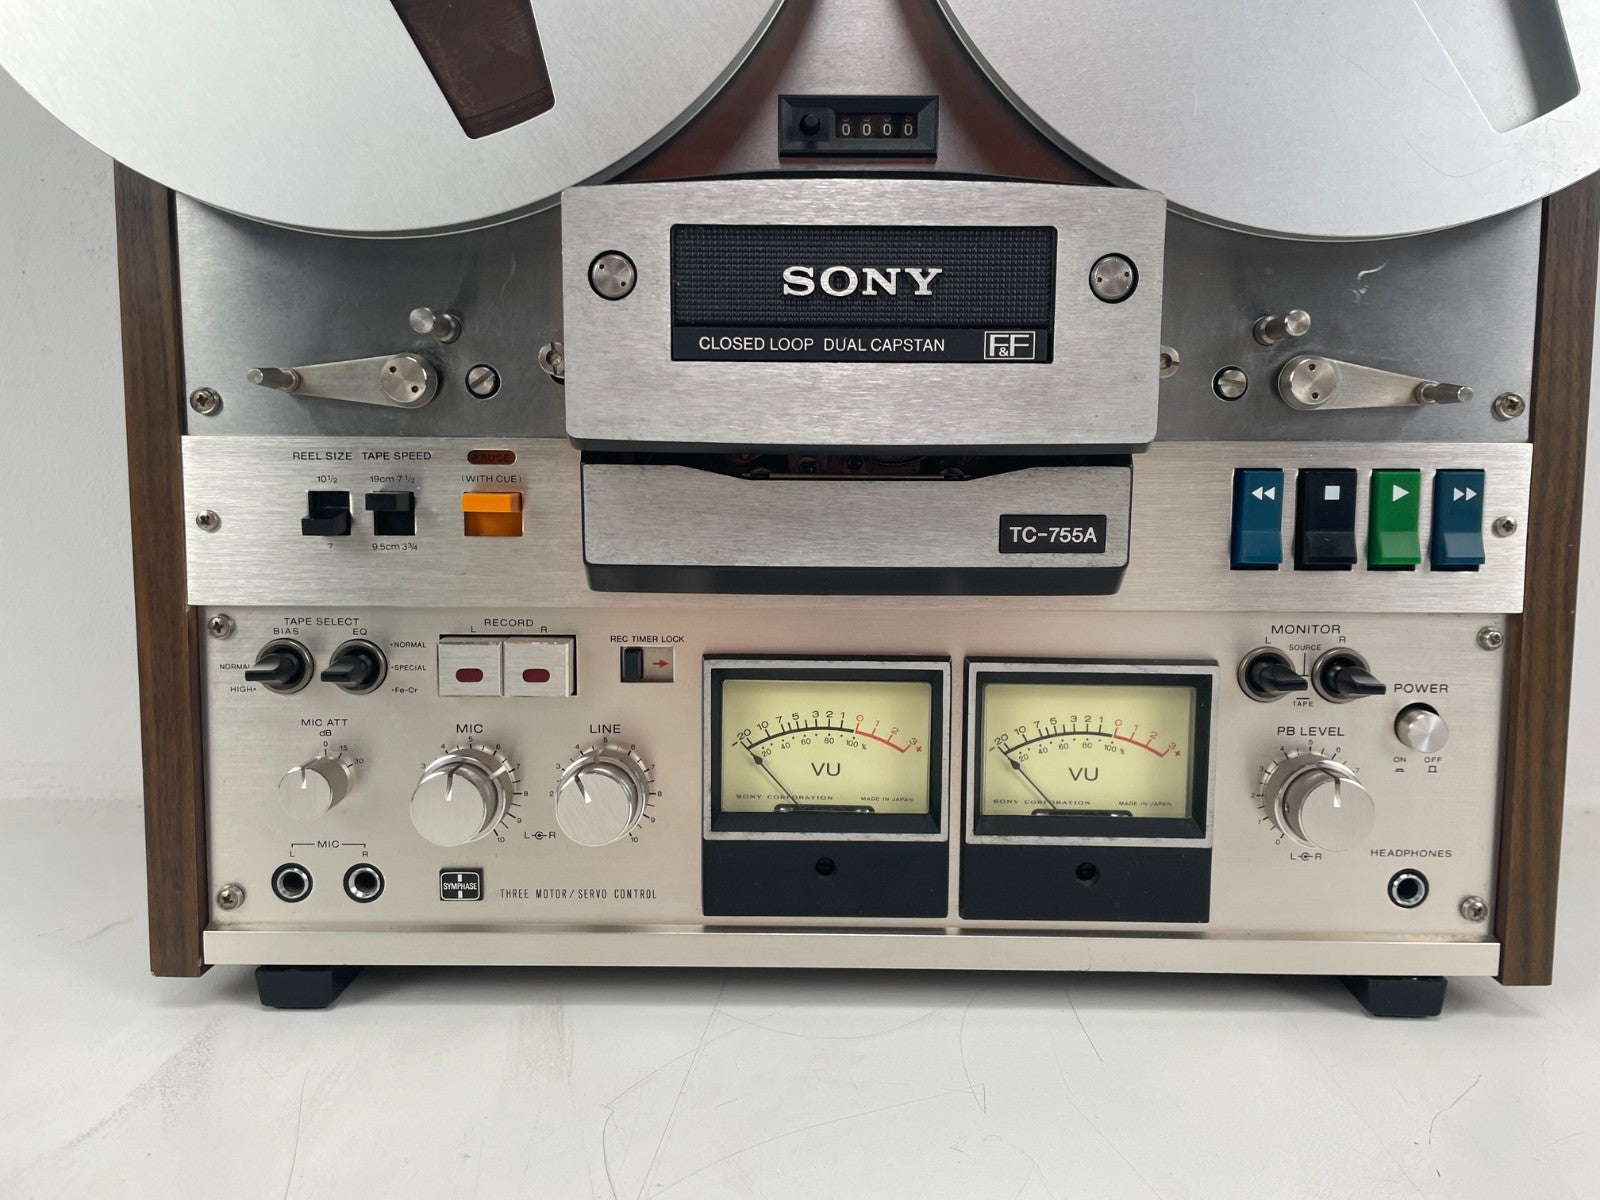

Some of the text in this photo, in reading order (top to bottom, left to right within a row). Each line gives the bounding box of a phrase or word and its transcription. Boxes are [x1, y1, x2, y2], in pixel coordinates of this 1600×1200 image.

[782, 265, 943, 297] SONY
[699, 336, 945, 352] CLOSED LOOP DUAL CAPSTAN
[293, 452, 353, 460] REEL SIZE
[362, 452, 432, 460] TAPE SPEED
[473, 453, 510, 462] PAUSE
[370, 475, 395, 483] 19cm
[461, 474, 522, 483] (WITH CUE)
[1009, 526, 1097, 543] TC-755A
[284, 618, 360, 626] TAPE SELECT
[484, 618, 534, 627] RECORD
[352, 628, 368, 636] EQ
[1271, 624, 1341, 634] MONITOR
[610, 635, 685, 643] REC TIMER LOCK
[1339, 636, 1346, 644] R
[1394, 683, 1449, 693] POWER
[301, 719, 348, 727] MIC ATT
[756, 721, 769, 730] 10
[792, 712, 800, 720] 5
[812, 710, 820, 718] 3
[826, 710, 834, 718] 2
[856, 714, 864, 722] 0
[891, 727, 899, 735] 2
[456, 724, 484, 734] MIC
[589, 724, 621, 734] LINE
[1014, 725, 1027, 736] 10
[1033, 720, 1040, 729] 7
[1050, 717, 1057, 725] 5
[1070, 715, 1078, 723] 3
[1084, 715, 1092, 723] 2
[1114, 719, 1123, 727] 0
[1150, 731, 1158, 740] 2
[1277, 726, 1345, 736] PB LEVEL
[320, 729, 332, 737] dB
[761, 748, 772, 757] 20
[781, 742, 791, 750] 40
[1019, 753, 1029, 762] 20
[1058, 742, 1069, 751] 60
[811, 763, 841, 777] VU
[1068, 767, 1099, 782] VU
[317, 840, 340, 848] MIC
[1370, 849, 1452, 858] HEADPHONES
[442, 882, 478, 890] SYMPHASE
[500, 889, 529, 899] THREE
[614, 889, 657, 899] CONTROL
